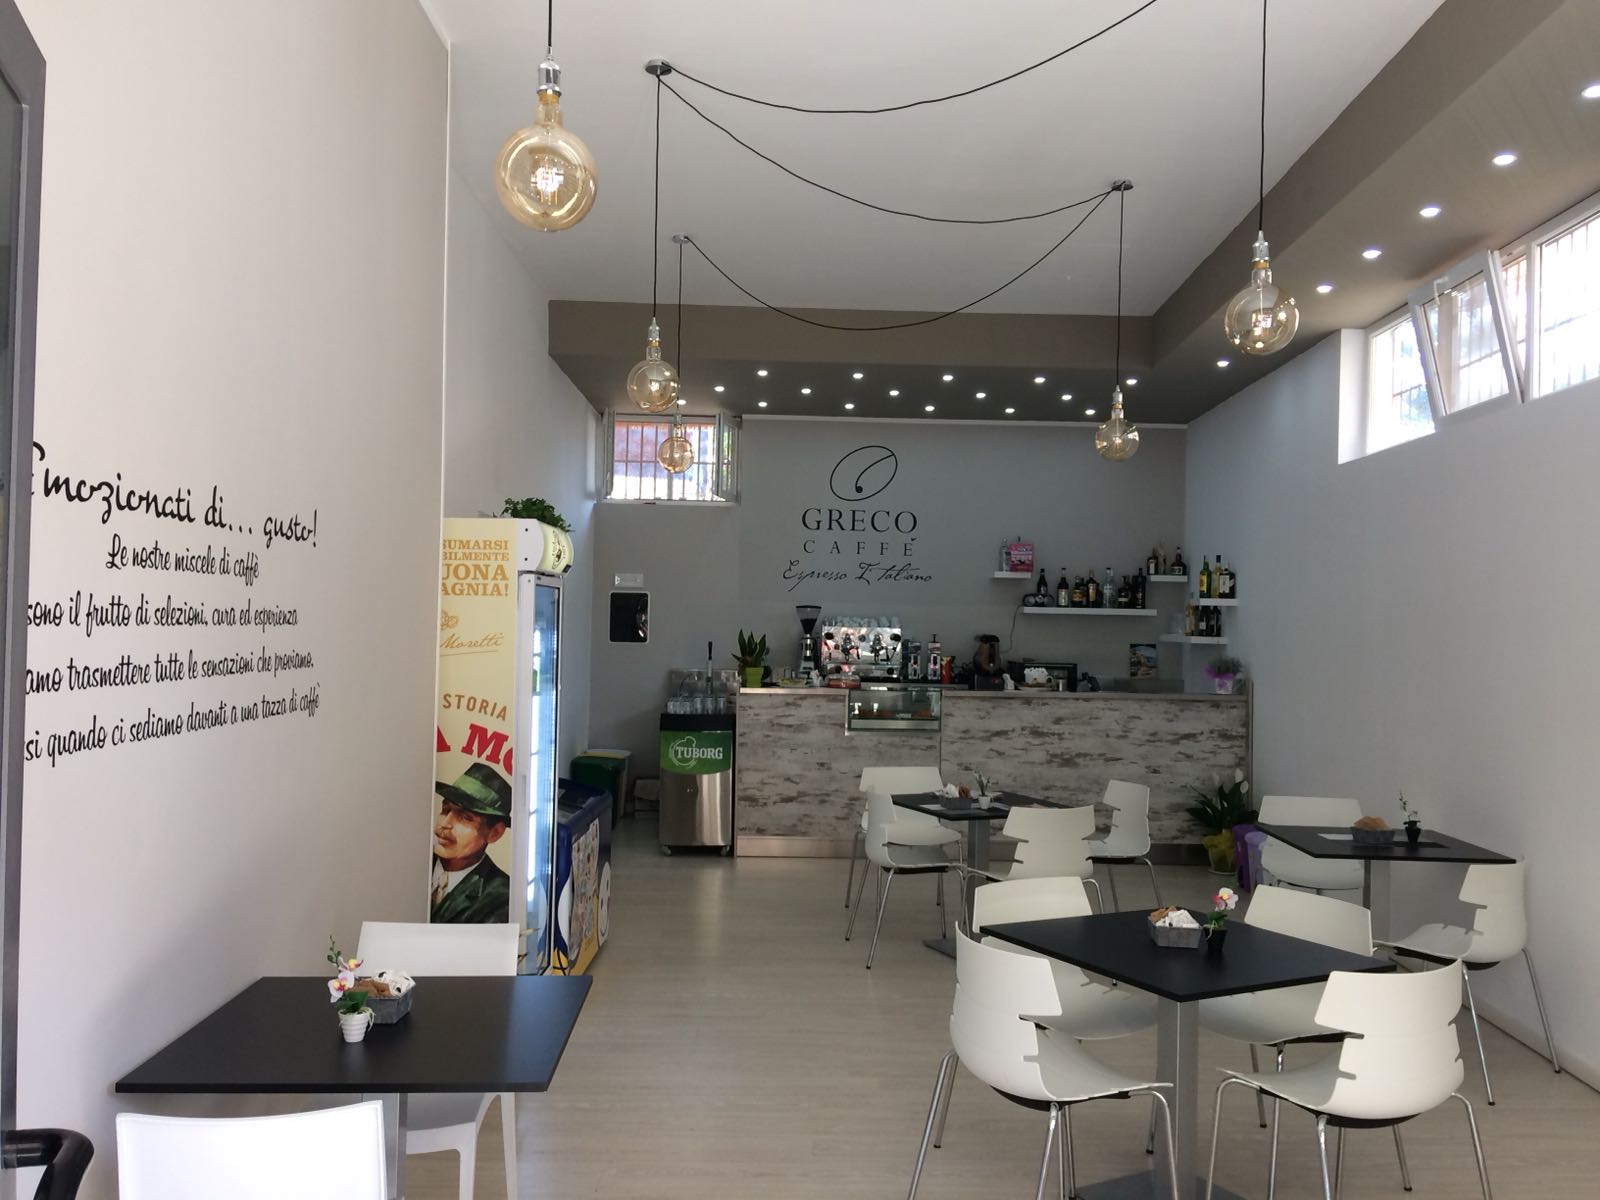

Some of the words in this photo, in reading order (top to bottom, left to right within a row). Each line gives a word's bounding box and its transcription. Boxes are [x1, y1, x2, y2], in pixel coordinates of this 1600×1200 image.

[263, 509, 318, 549] gusto!
[801, 507, 918, 534] GRECO
[105, 533, 129, 570] Le
[132, 540, 172, 572] nostre
[174, 545, 216, 575] miscele
[219, 546, 232, 576] di
[233, 551, 260, 587] caffè
[782, 559, 848, 593] Espresso
[854, 561, 934, 587] Italiano
[441, 582, 509, 597] AGNIA!
[27, 601, 64, 627] sono
[69, 590, 82, 627] il
[85, 593, 132, 638] frutto
[135, 593, 151, 627] di
[211, 607, 237, 627] cura
[239, 598, 253, 626] ed
[254, 605, 299, 633] esperienza
[440, 632, 504, 649] Moretti
[25, 668, 63, 695] amo
[66, 655, 152, 692] trasmettere
[153, 652, 186, 683] tutte
[187, 649, 199, 680] le
[201, 651, 255, 678] sensazioni
[256, 645, 273, 674] che
[442, 692, 508, 721] STORIA
[47, 715, 108, 769] quando
[111, 718, 127, 746] ci
[129, 707, 184, 743] sediamo
[186, 700, 228, 733] davanti
[230, 705, 239, 726] a
[240, 702, 259, 722] una
[261, 694, 287, 719] tazza
[288, 687, 298, 714] di
[299, 682, 322, 718] caffè
[675, 746, 724, 760] TUBORG
